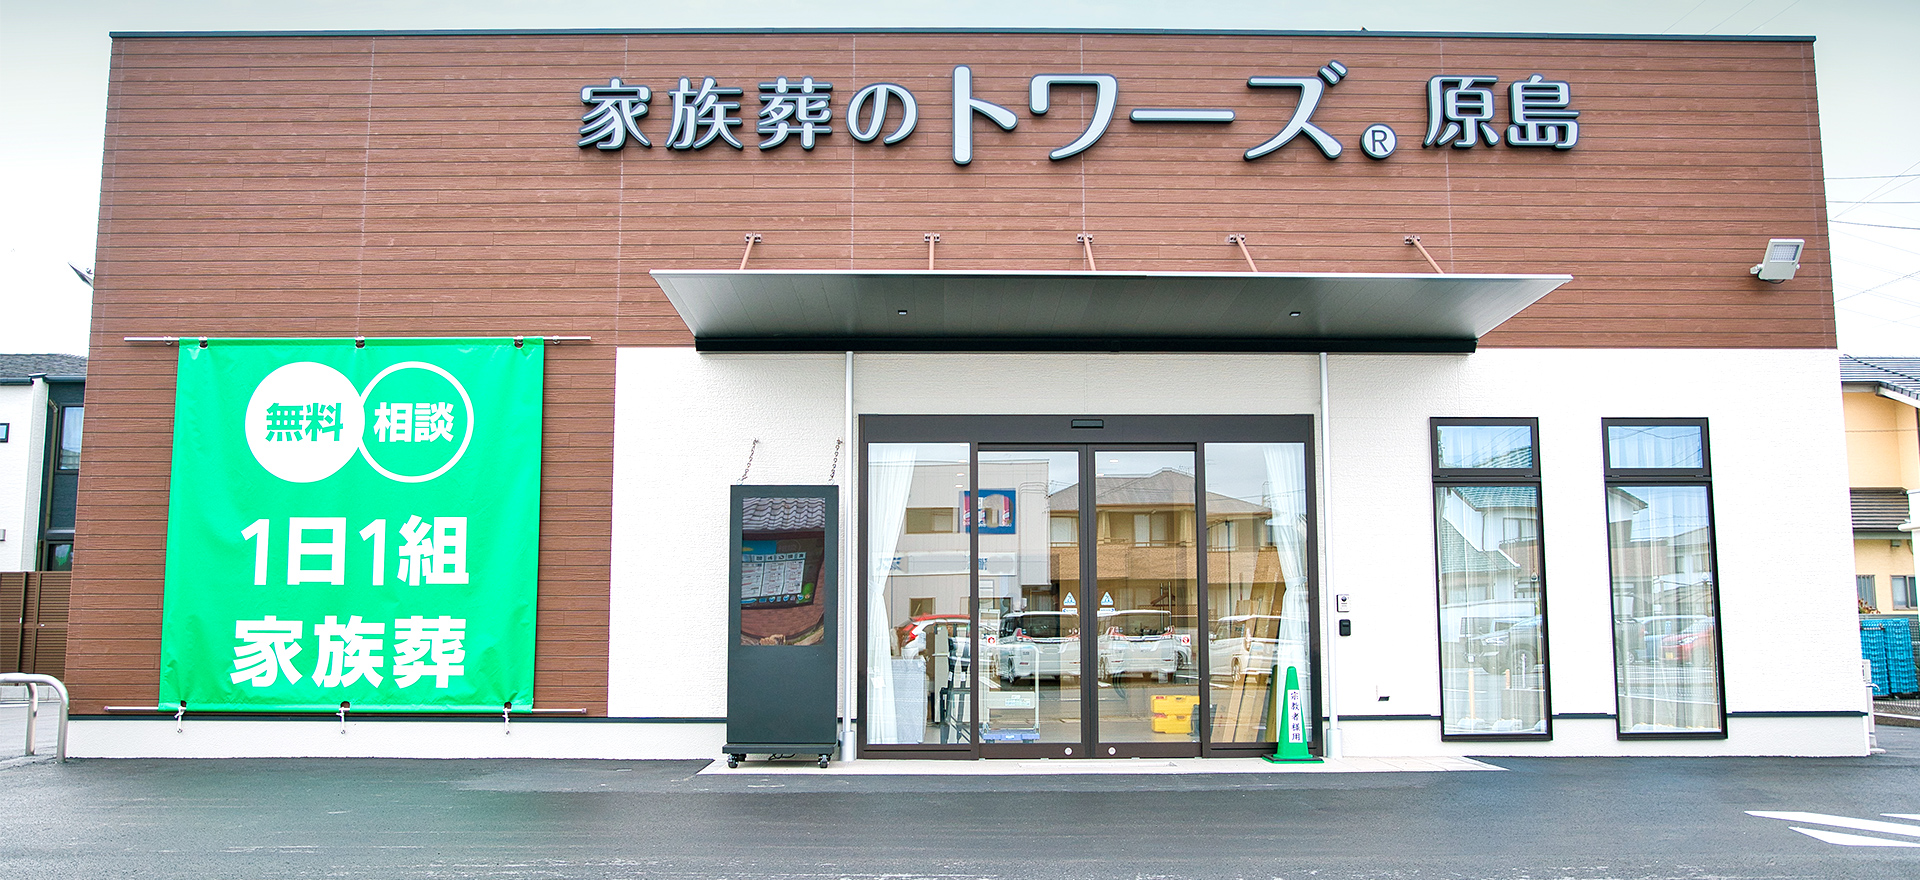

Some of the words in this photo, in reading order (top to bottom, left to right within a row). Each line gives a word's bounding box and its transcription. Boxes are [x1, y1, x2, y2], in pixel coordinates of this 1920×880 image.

[265, 402, 344, 442] 無料
[373, 402, 455, 442] 相談
[241, 514, 470, 587] 1日1組
[230, 615, 467, 689] 家族葬
[1290, 691, 1301, 741] 宗教者様用
